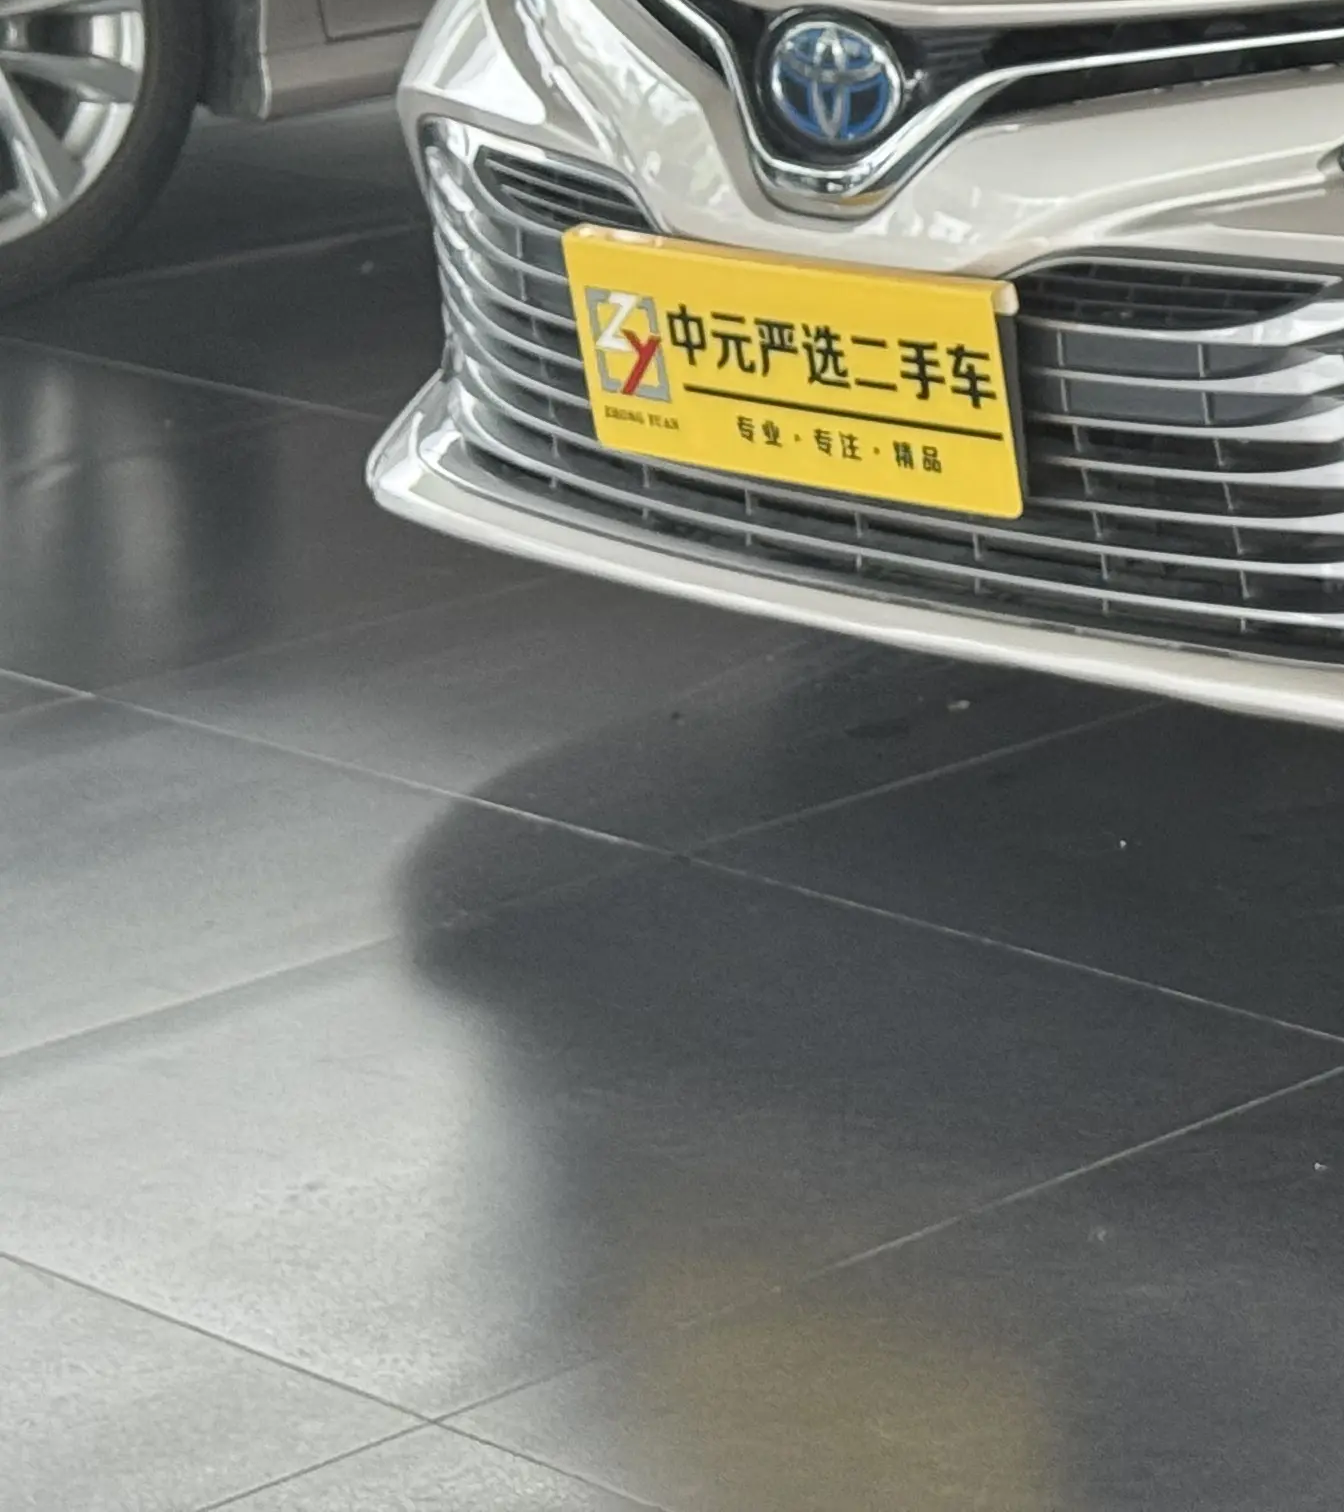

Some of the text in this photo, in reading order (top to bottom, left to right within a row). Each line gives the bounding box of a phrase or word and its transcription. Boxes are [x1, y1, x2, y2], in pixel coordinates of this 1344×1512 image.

[666, 303, 998, 410] 中元严选二手车
